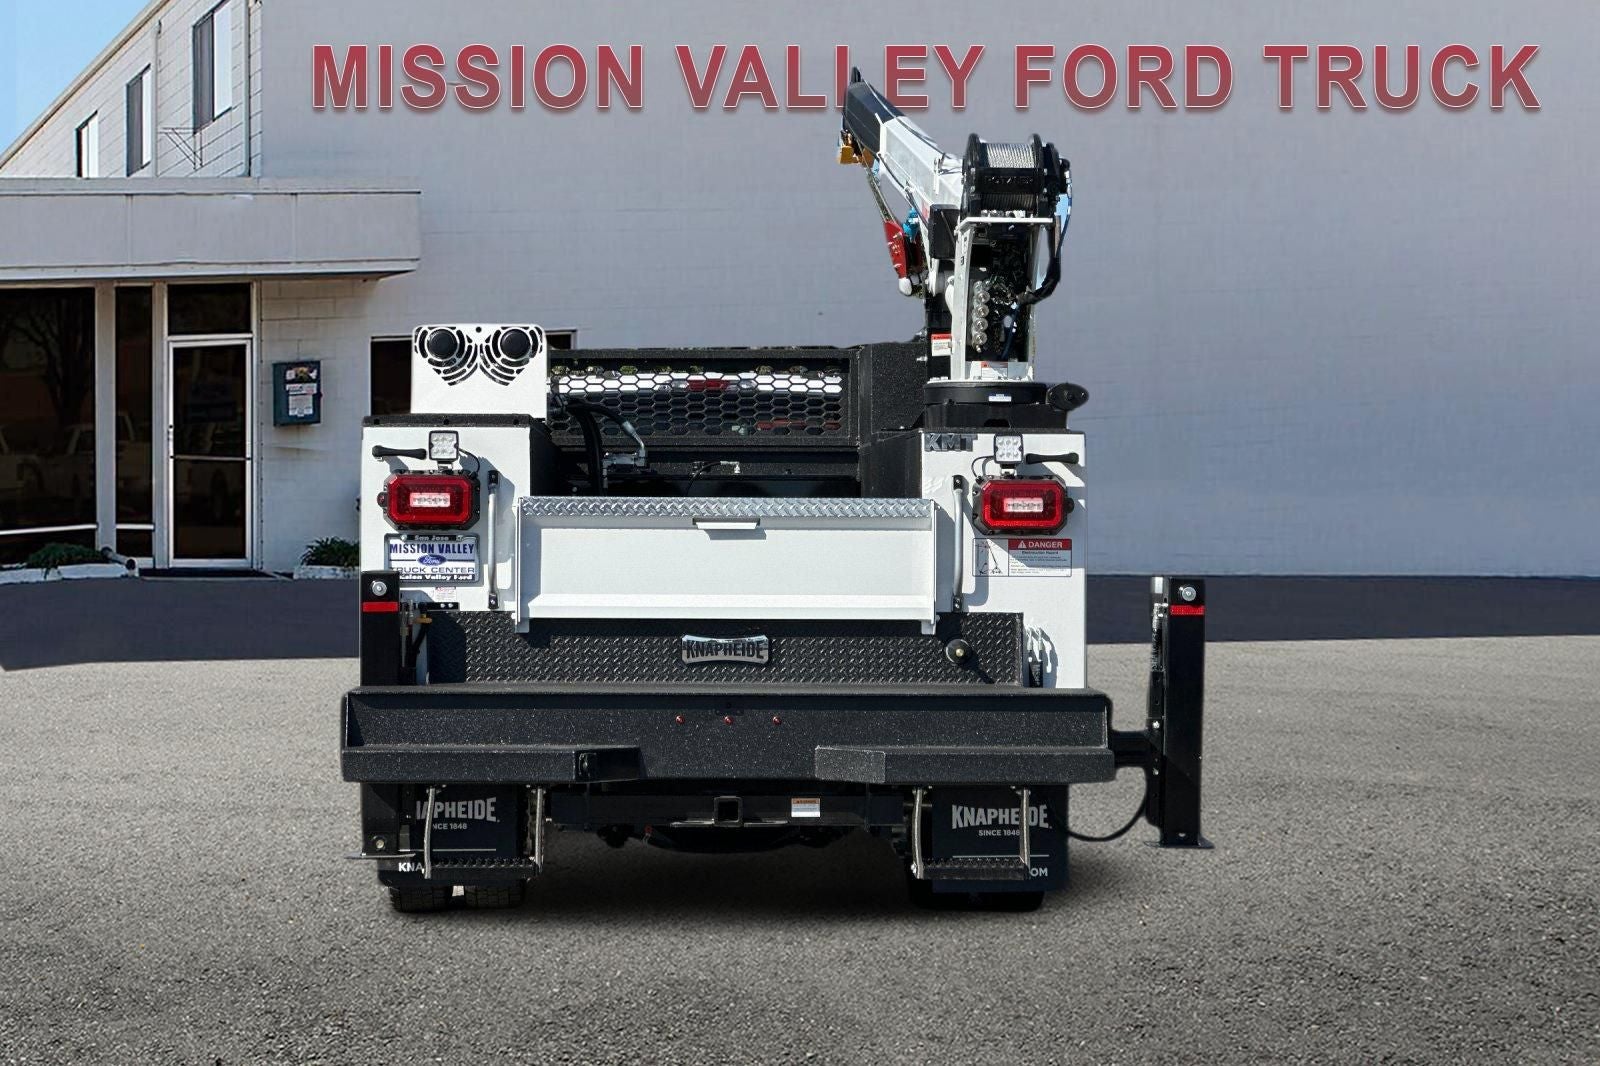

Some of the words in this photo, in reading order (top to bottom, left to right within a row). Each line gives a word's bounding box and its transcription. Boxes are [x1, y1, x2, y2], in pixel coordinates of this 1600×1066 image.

[311, 44, 644, 109] MISSION
[676, 44, 985, 109] VALLEY
[1014, 44, 1234, 109] FORD
[1263, 44, 1541, 109] TRUCK
[924, 432, 978, 452] KMT
[390, 543, 434, 554] MISSION
[438, 543, 474, 554] VALLEY
[1028, 541, 1063, 549] DANGER
[423, 555, 441, 564] Ford
[686, 639, 765, 660] KNAPHEIDE
[952, 804, 1049, 830] KNAPHEDE
[978, 829, 1001, 837] SINCE
[1003, 829, 1021, 837] 1848
